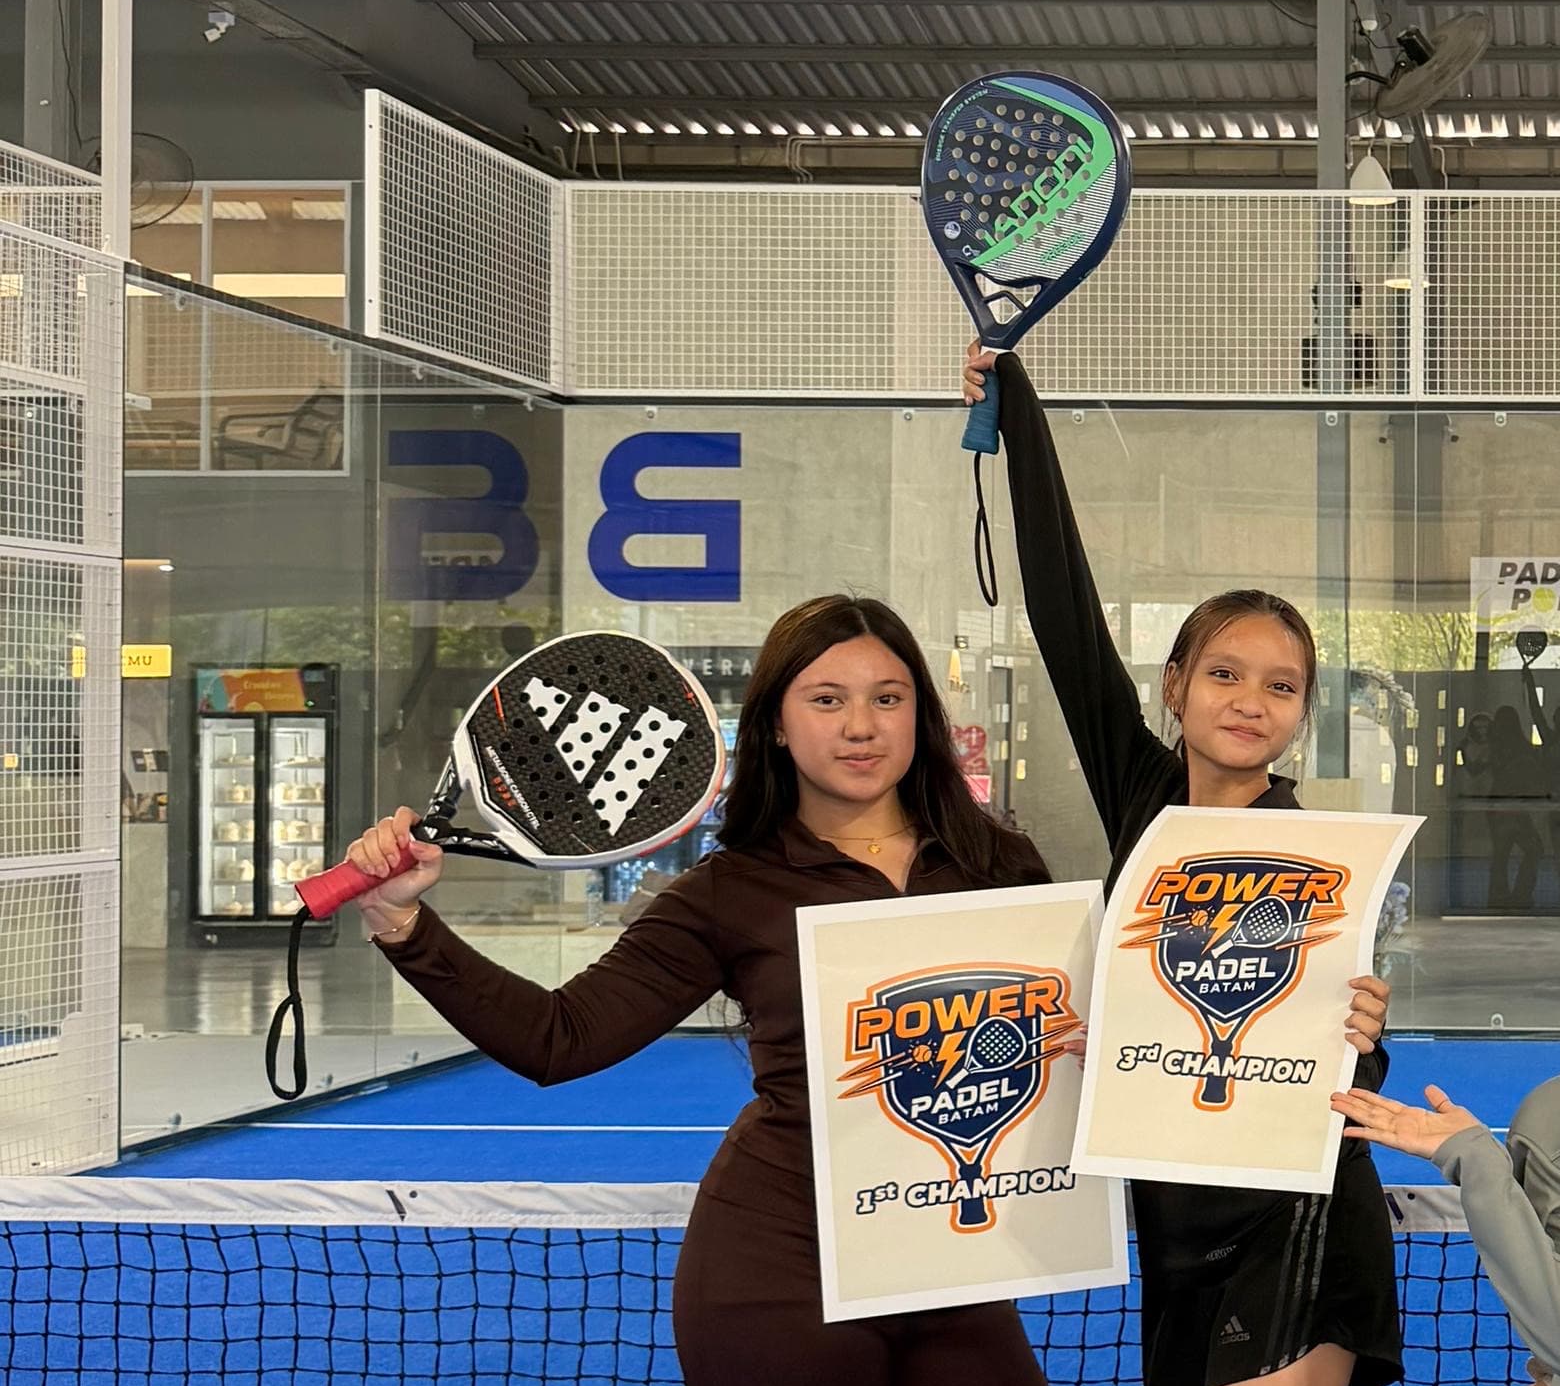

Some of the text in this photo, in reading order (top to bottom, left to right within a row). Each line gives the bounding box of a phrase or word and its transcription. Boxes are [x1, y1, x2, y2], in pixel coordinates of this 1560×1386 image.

[683, 659, 753, 676] VERA
[510, 784, 531, 813] CARBON
[1149, 871, 1344, 903] POWER
[1175, 958, 1276, 983] PADEL
[1200, 980, 1256, 994] BATAM
[856, 979, 1065, 1046] POWER
[1118, 1043, 1316, 1084] 3rd CHAMPION
[910, 1078, 1020, 1119] PADEL
[938, 1103, 999, 1125] BATAM
[857, 1167, 1076, 1214] 1st CHAMPION
